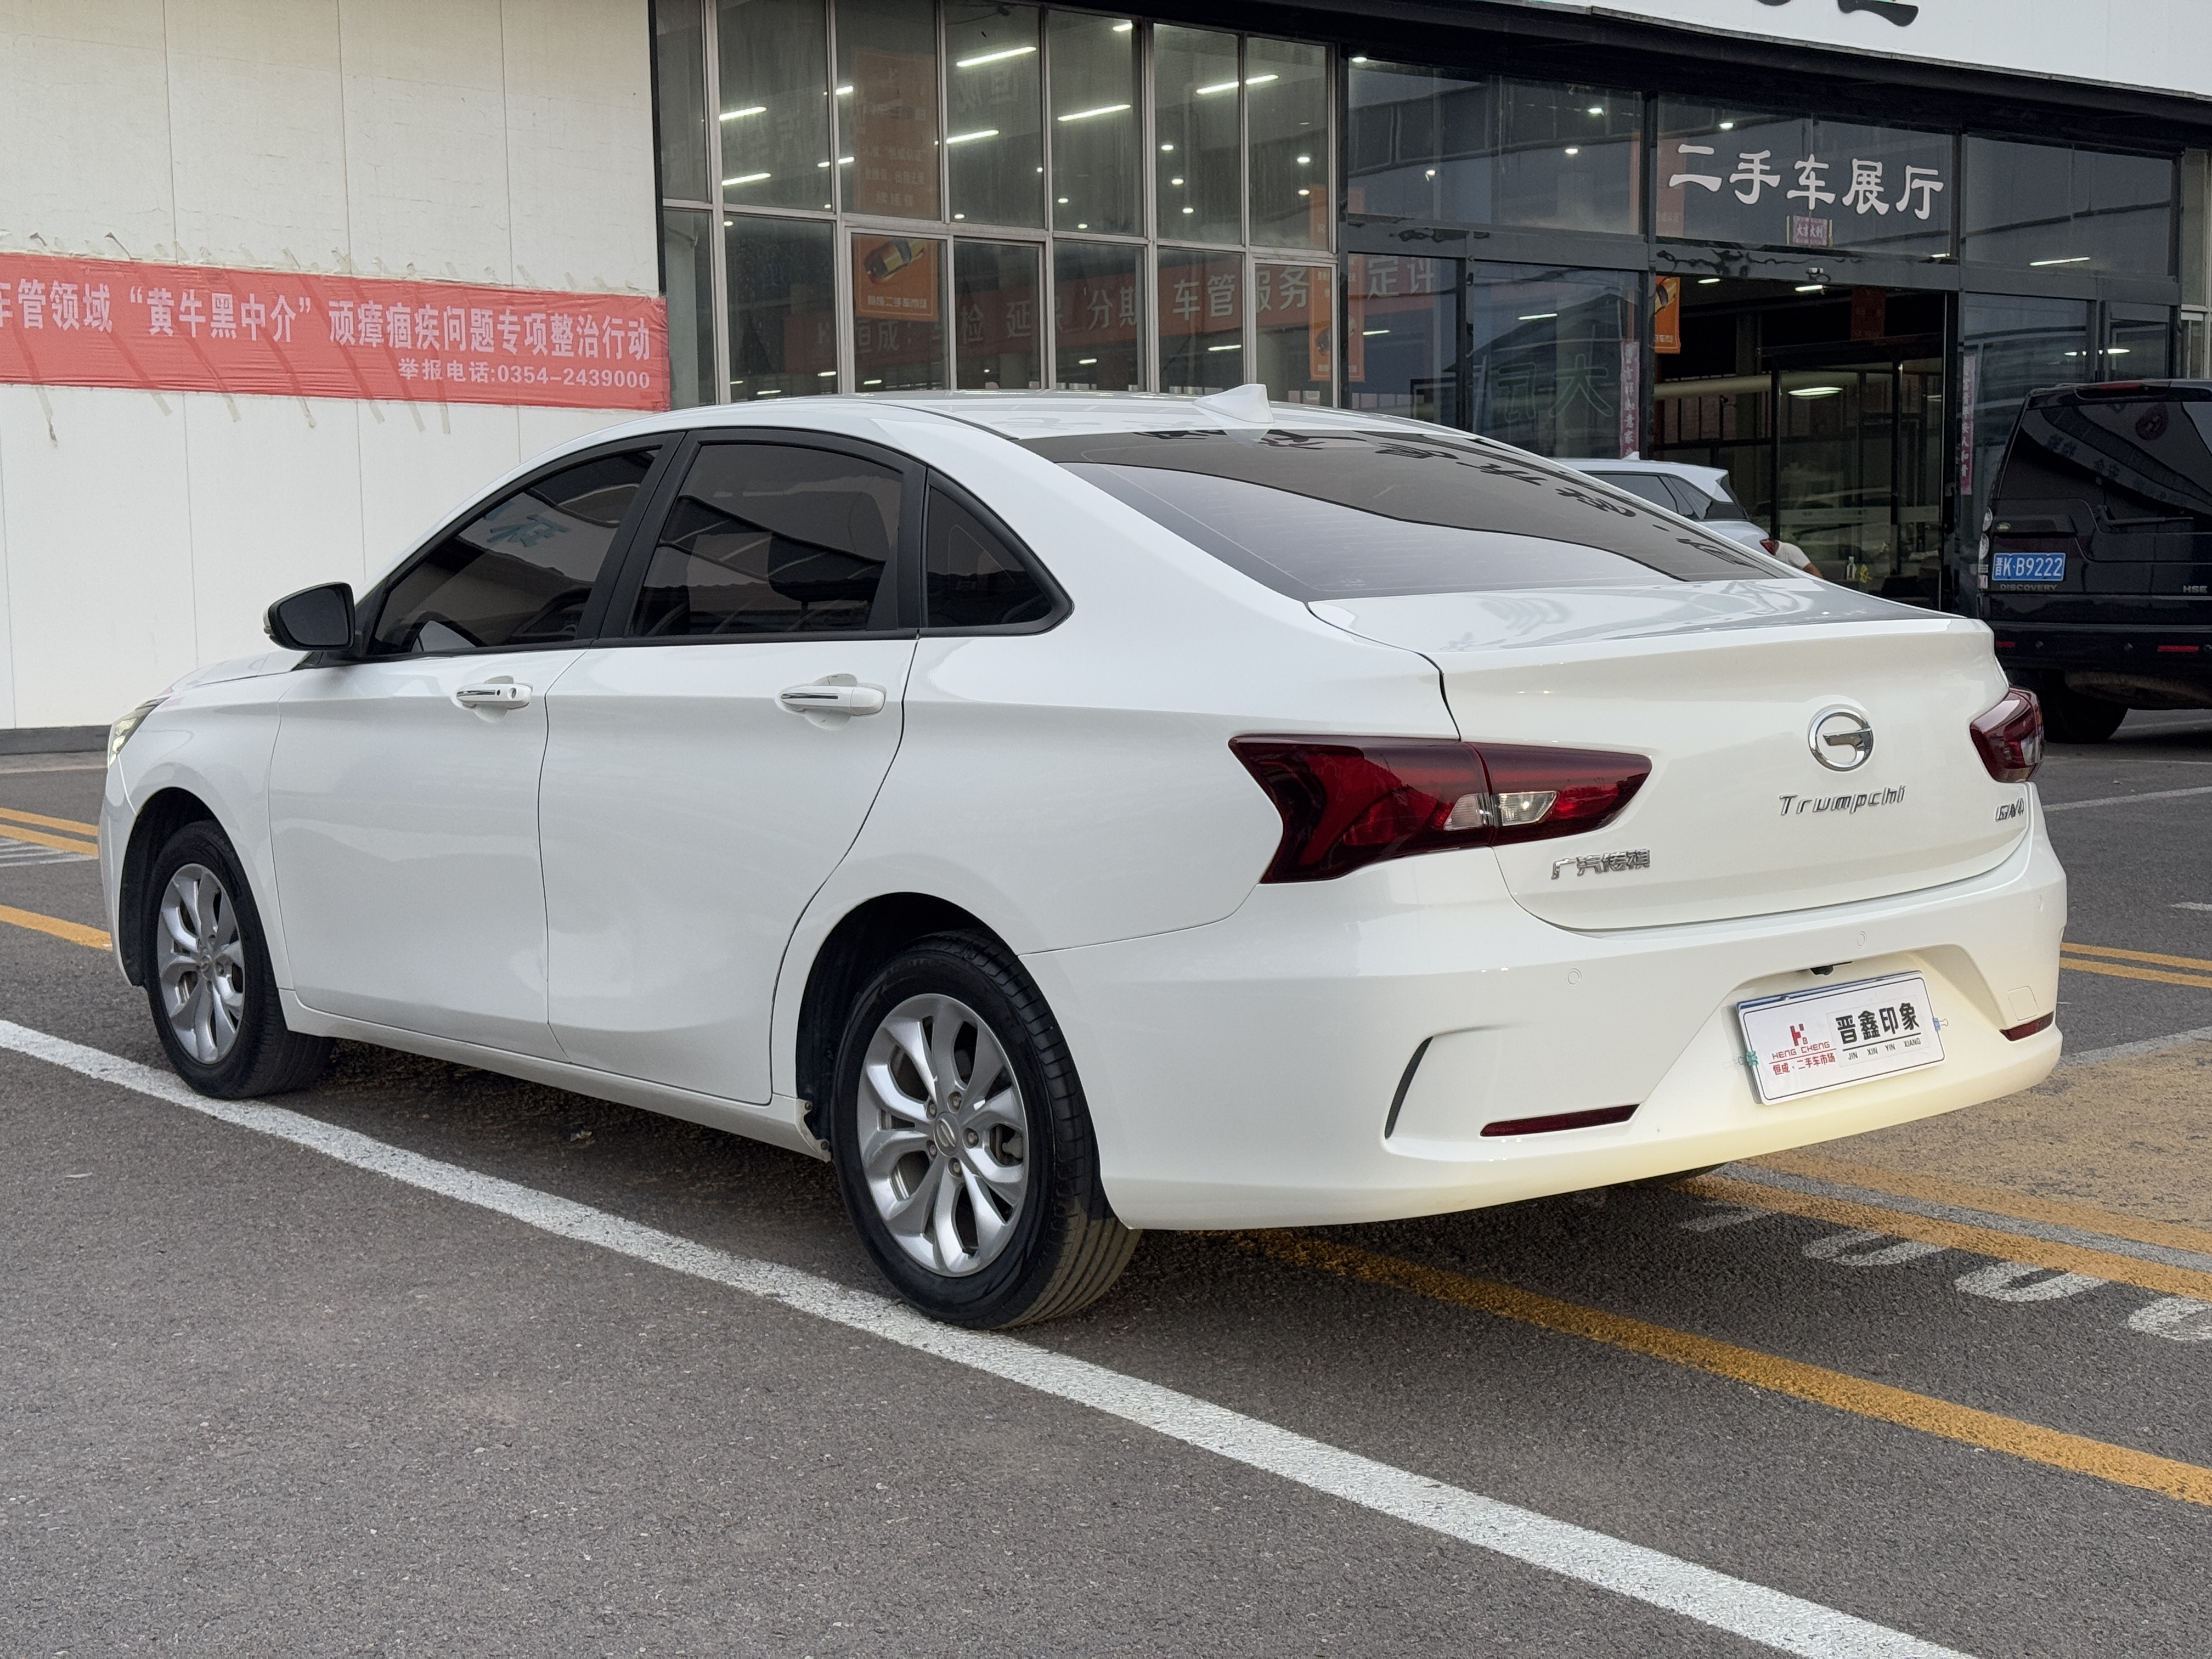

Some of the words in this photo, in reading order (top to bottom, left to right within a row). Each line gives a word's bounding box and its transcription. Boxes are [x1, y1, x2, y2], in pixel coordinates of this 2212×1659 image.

[1668, 143, 1945, 221] 二手车展厅
[2183, 585, 2208, 594] HSE
[1779, 785, 1906, 816] Trumpchi
[1550, 848, 1651, 880] 广汽传祺
[1835, 1002, 1920, 1045] 晋鑫印象
[1772, 1048, 1797, 1060] HENG
[1801, 1041, 1831, 1054] CHENG
[1848, 1051, 1859, 1060] JIN
[1866, 1047, 1878, 1057] XIN
[1884, 1042, 1896, 1053] YIN
[1903, 1037, 1922, 1048] XIANG
